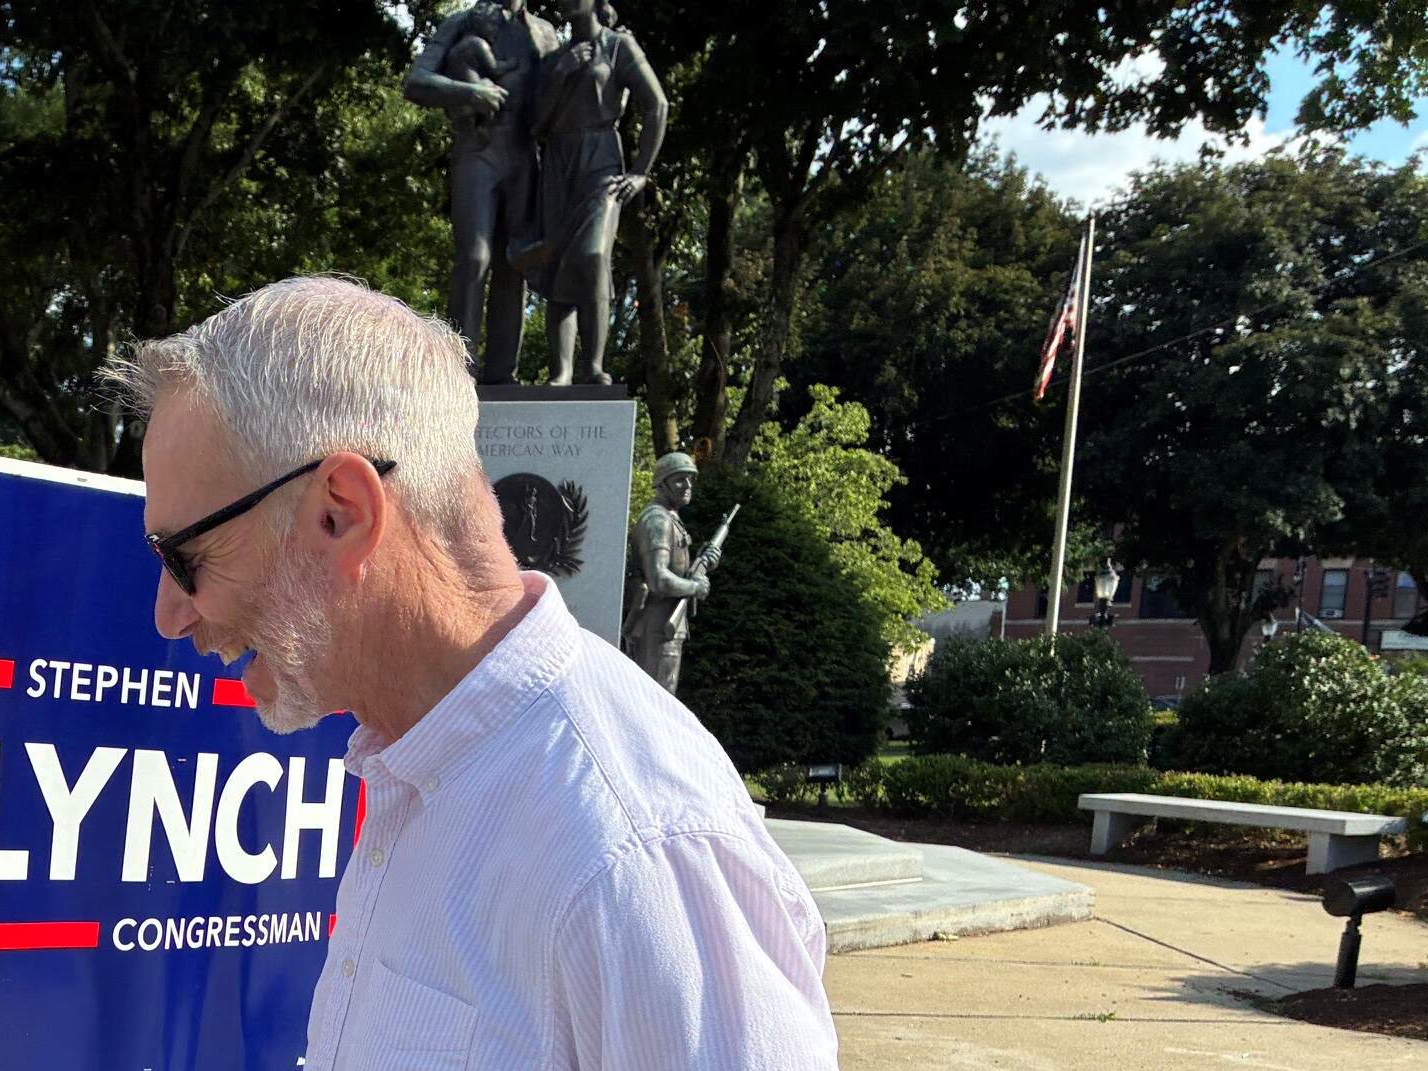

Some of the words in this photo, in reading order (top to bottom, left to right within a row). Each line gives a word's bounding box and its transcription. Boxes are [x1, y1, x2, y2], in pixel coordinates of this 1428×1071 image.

[549, 426, 568, 439] OF
[580, 426, 607, 439] THE
[551, 444, 581, 457] WAY
[26, 659, 201, 709] STEPHEN
[112, 912, 321, 951] CONGRESSMAN
